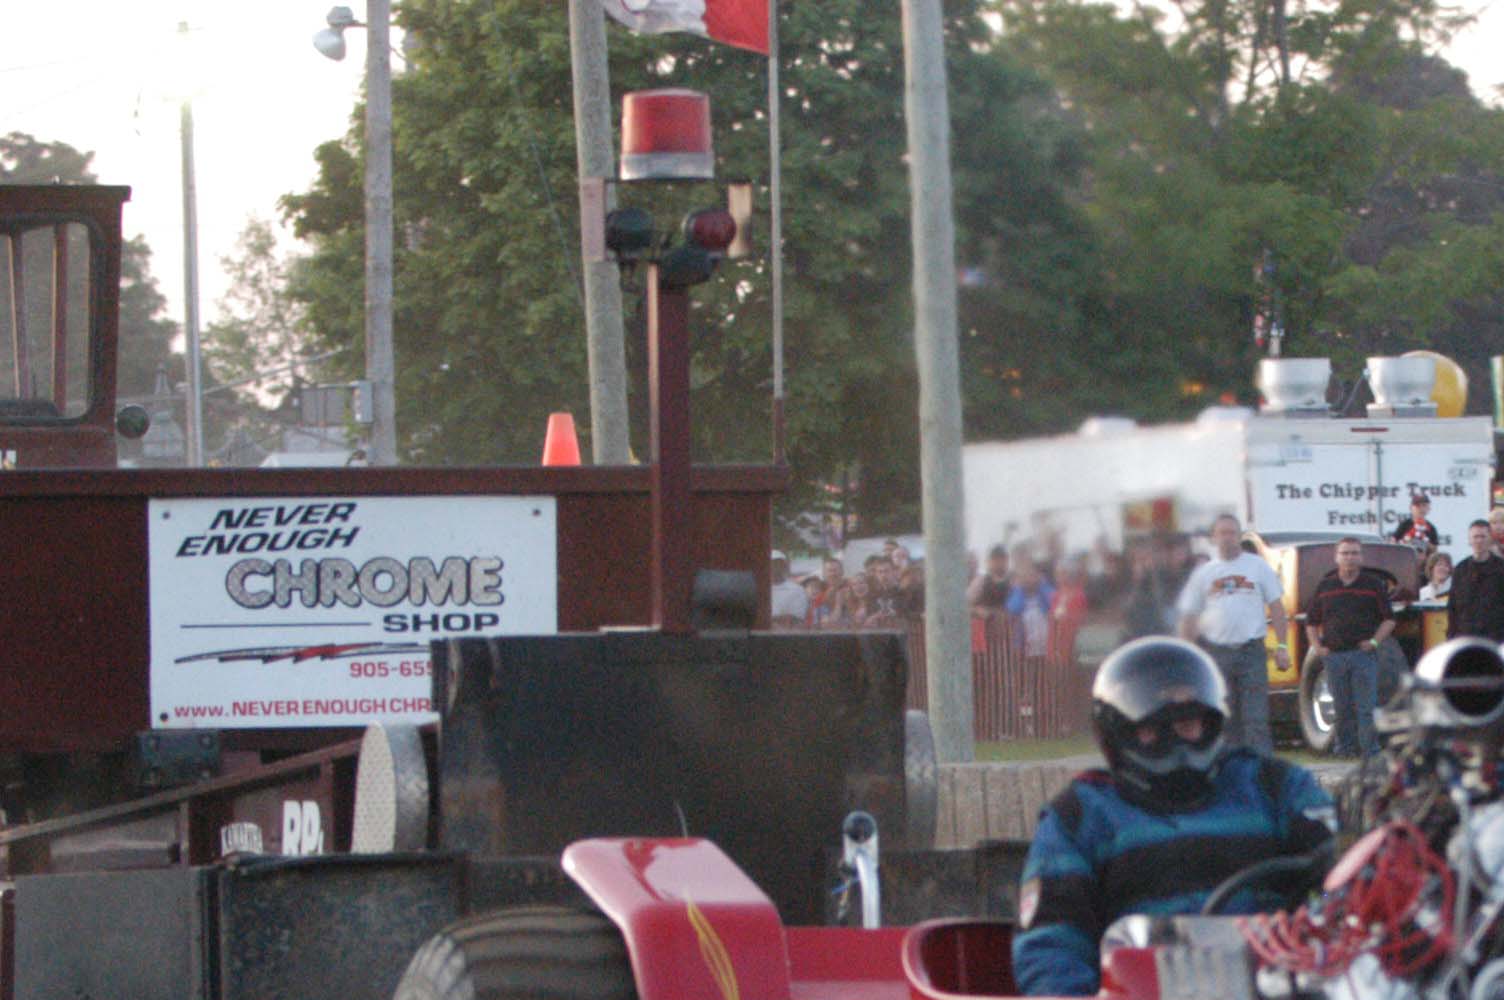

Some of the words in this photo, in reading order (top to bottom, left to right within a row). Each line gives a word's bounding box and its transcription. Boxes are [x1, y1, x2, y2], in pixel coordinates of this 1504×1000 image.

[1276, 483, 1313, 500] The
[1319, 481, 1400, 501] Chipper
[1406, 482, 1467, 498] Truck
[209, 502, 357, 530] NEVER
[1327, 510, 1378, 525] Fresh
[175, 526, 360, 557] ENOUGH
[225, 555, 505, 609] CHROME
[383, 612, 500, 632] SHOP
